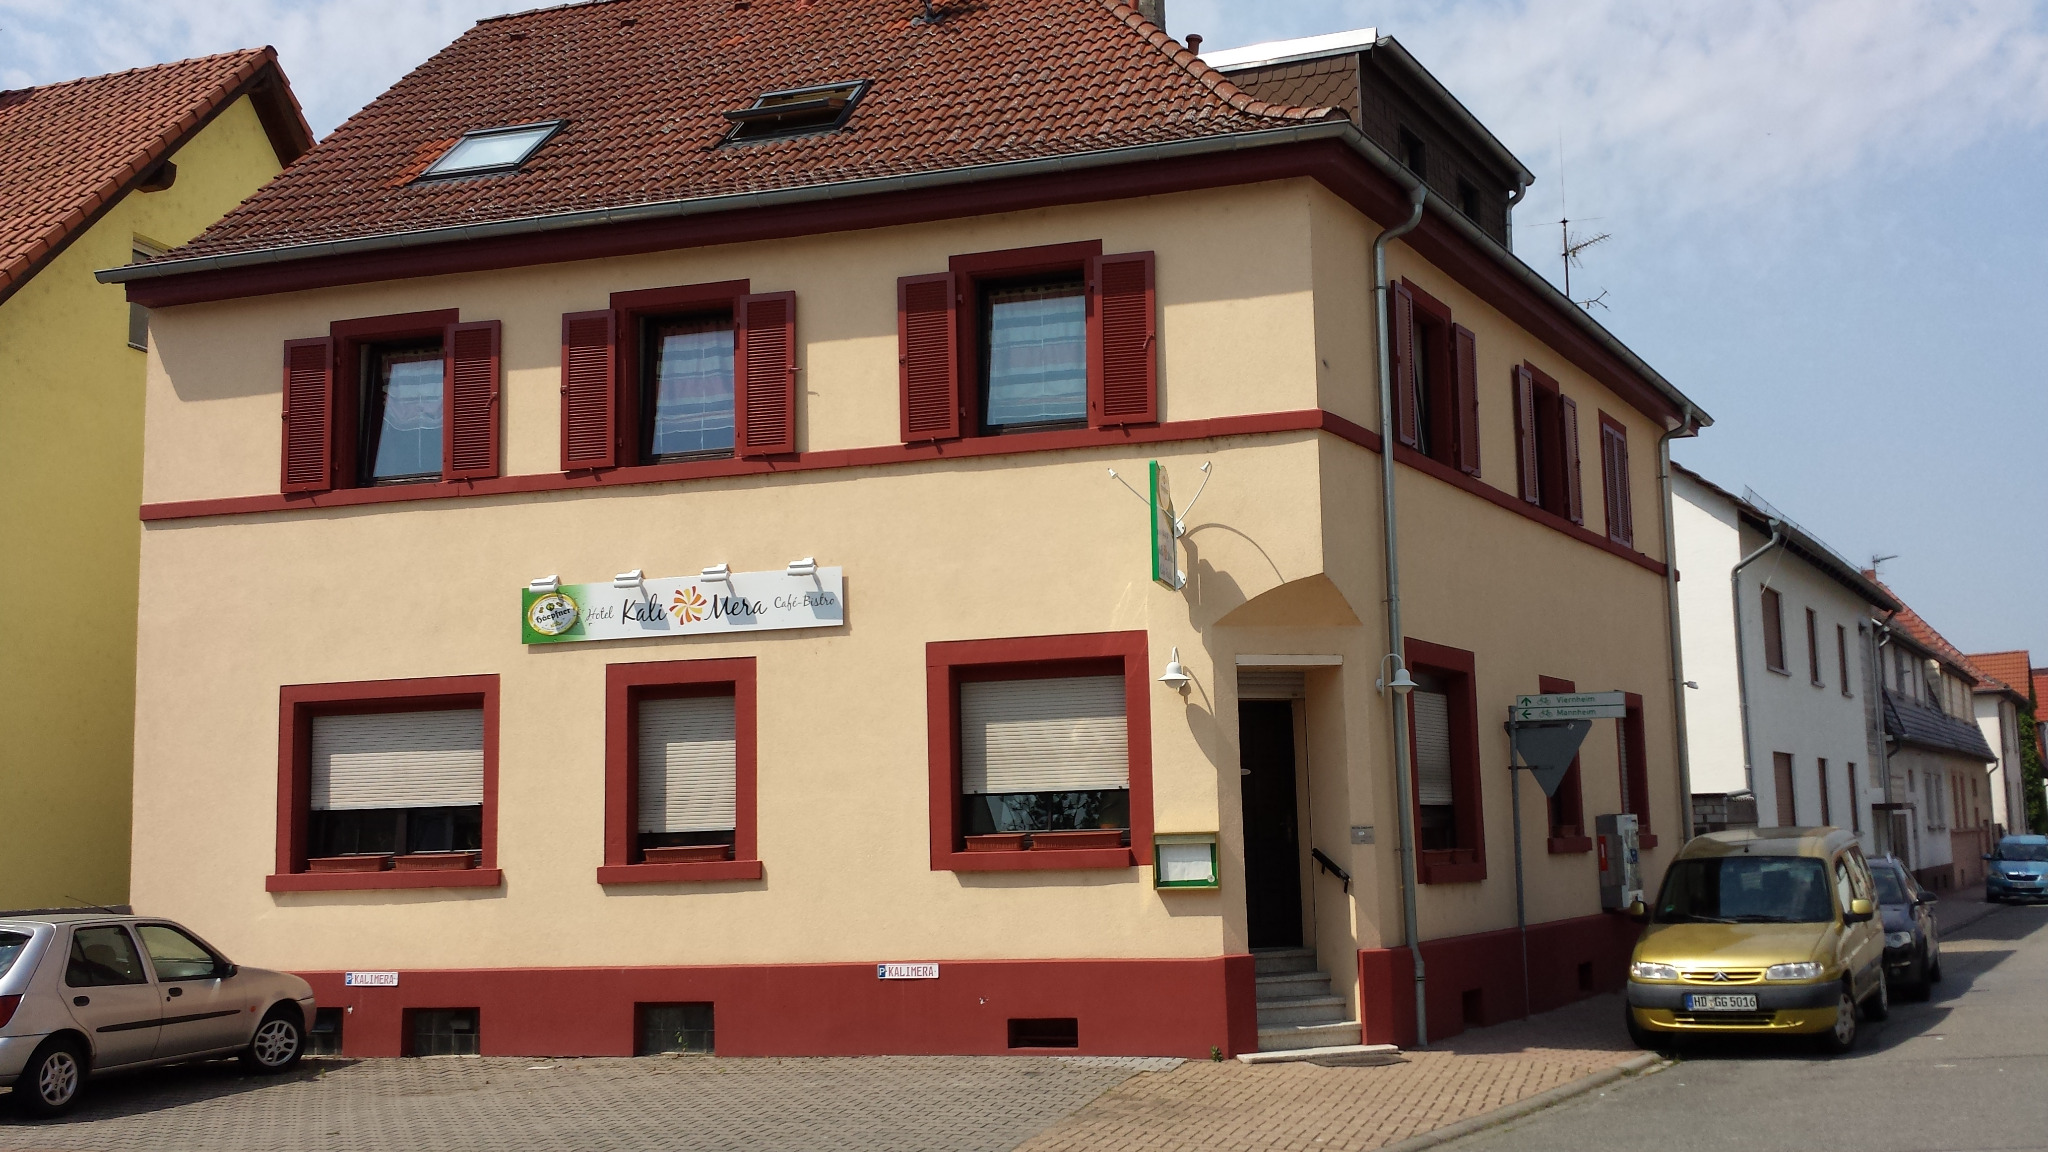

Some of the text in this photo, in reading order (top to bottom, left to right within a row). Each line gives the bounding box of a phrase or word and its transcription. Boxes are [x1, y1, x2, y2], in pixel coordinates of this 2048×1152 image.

[585, 605, 615, 622] Hotel
[621, 593, 668, 625] Kali
[703, 594, 768, 621] Mera
[1556, 695, 1595, 704] Viernheim
[1556, 708, 1597, 717] Mannheim
[888, 966, 934, 977] KALIMERA
[354, 974, 394, 985] KALIMERA
[1693, 996, 1756, 1007] HD GG 5016
